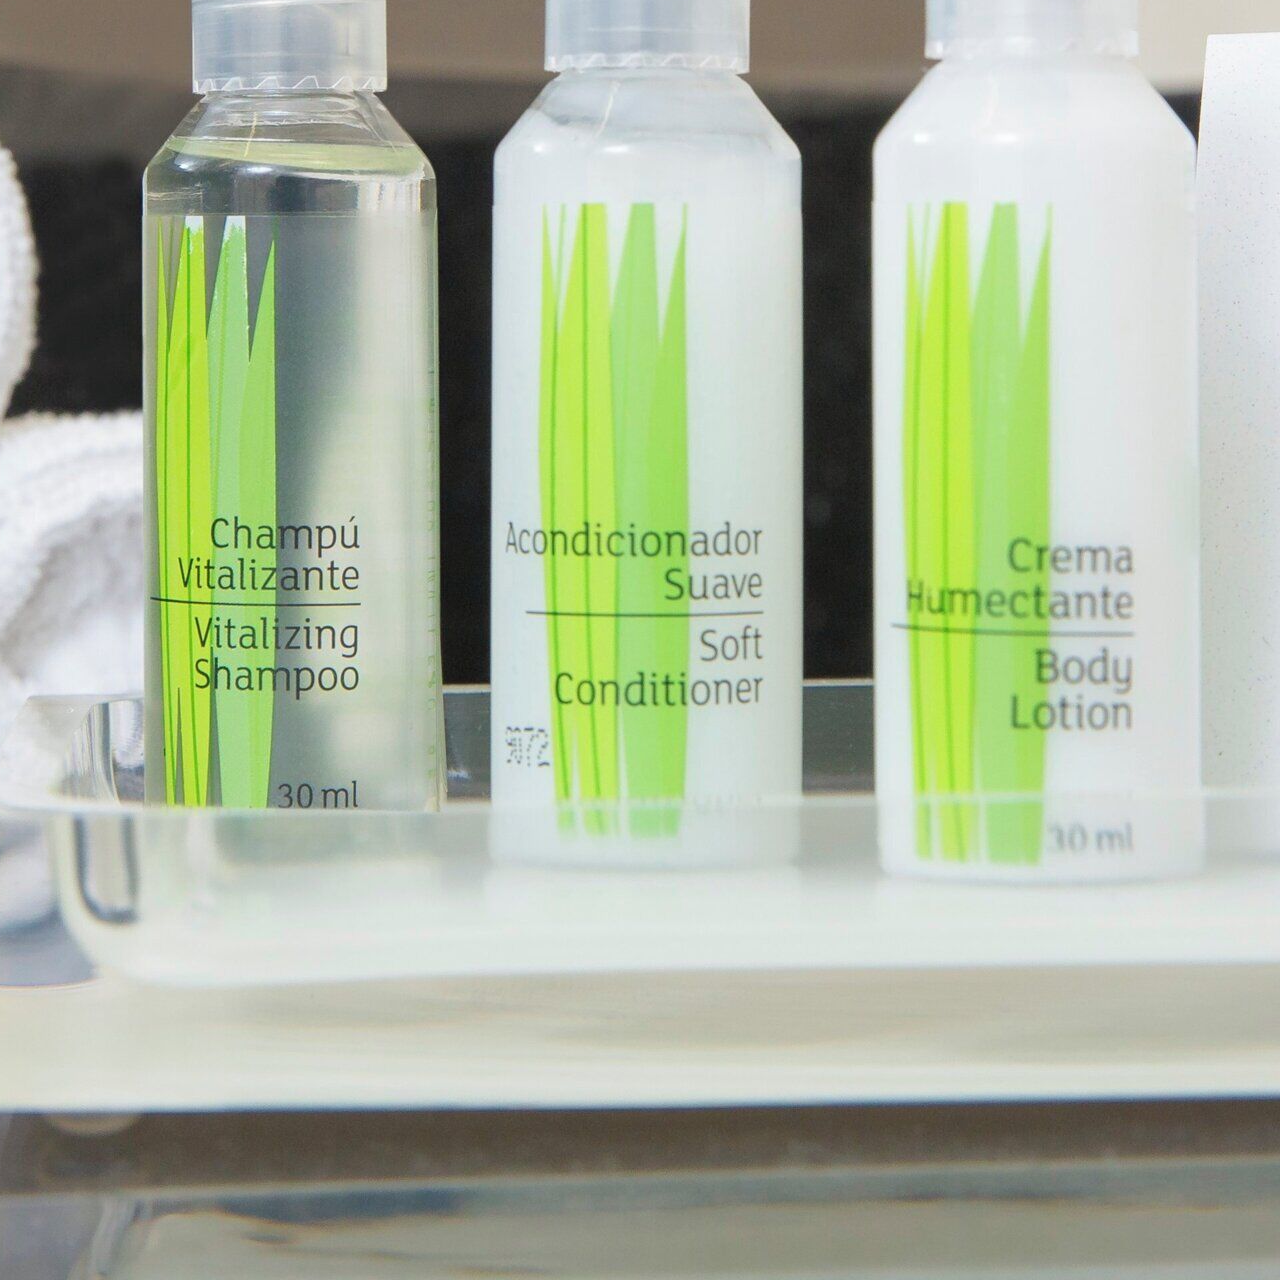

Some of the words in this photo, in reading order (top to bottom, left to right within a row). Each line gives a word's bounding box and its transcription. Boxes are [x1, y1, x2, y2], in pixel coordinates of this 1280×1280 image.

[209, 516, 361, 558] Champú
[505, 521, 763, 558] Acondicionador
[1007, 537, 1134, 574] Crema
[177, 557, 360, 592] Vitalizante
[663, 568, 763, 601] Suave
[905, 580, 1134, 620] Humectante
[194, 616, 359, 658] Vitalizing
[699, 625, 764, 662] Soft
[194, 657, 360, 700] Shampoo
[554, 671, 763, 707] Conditioner
[1034, 648, 1133, 694] Body
[1010, 695, 1133, 730] Lotion
[277, 783, 313, 809] 30
[320, 780, 359, 808] ml
